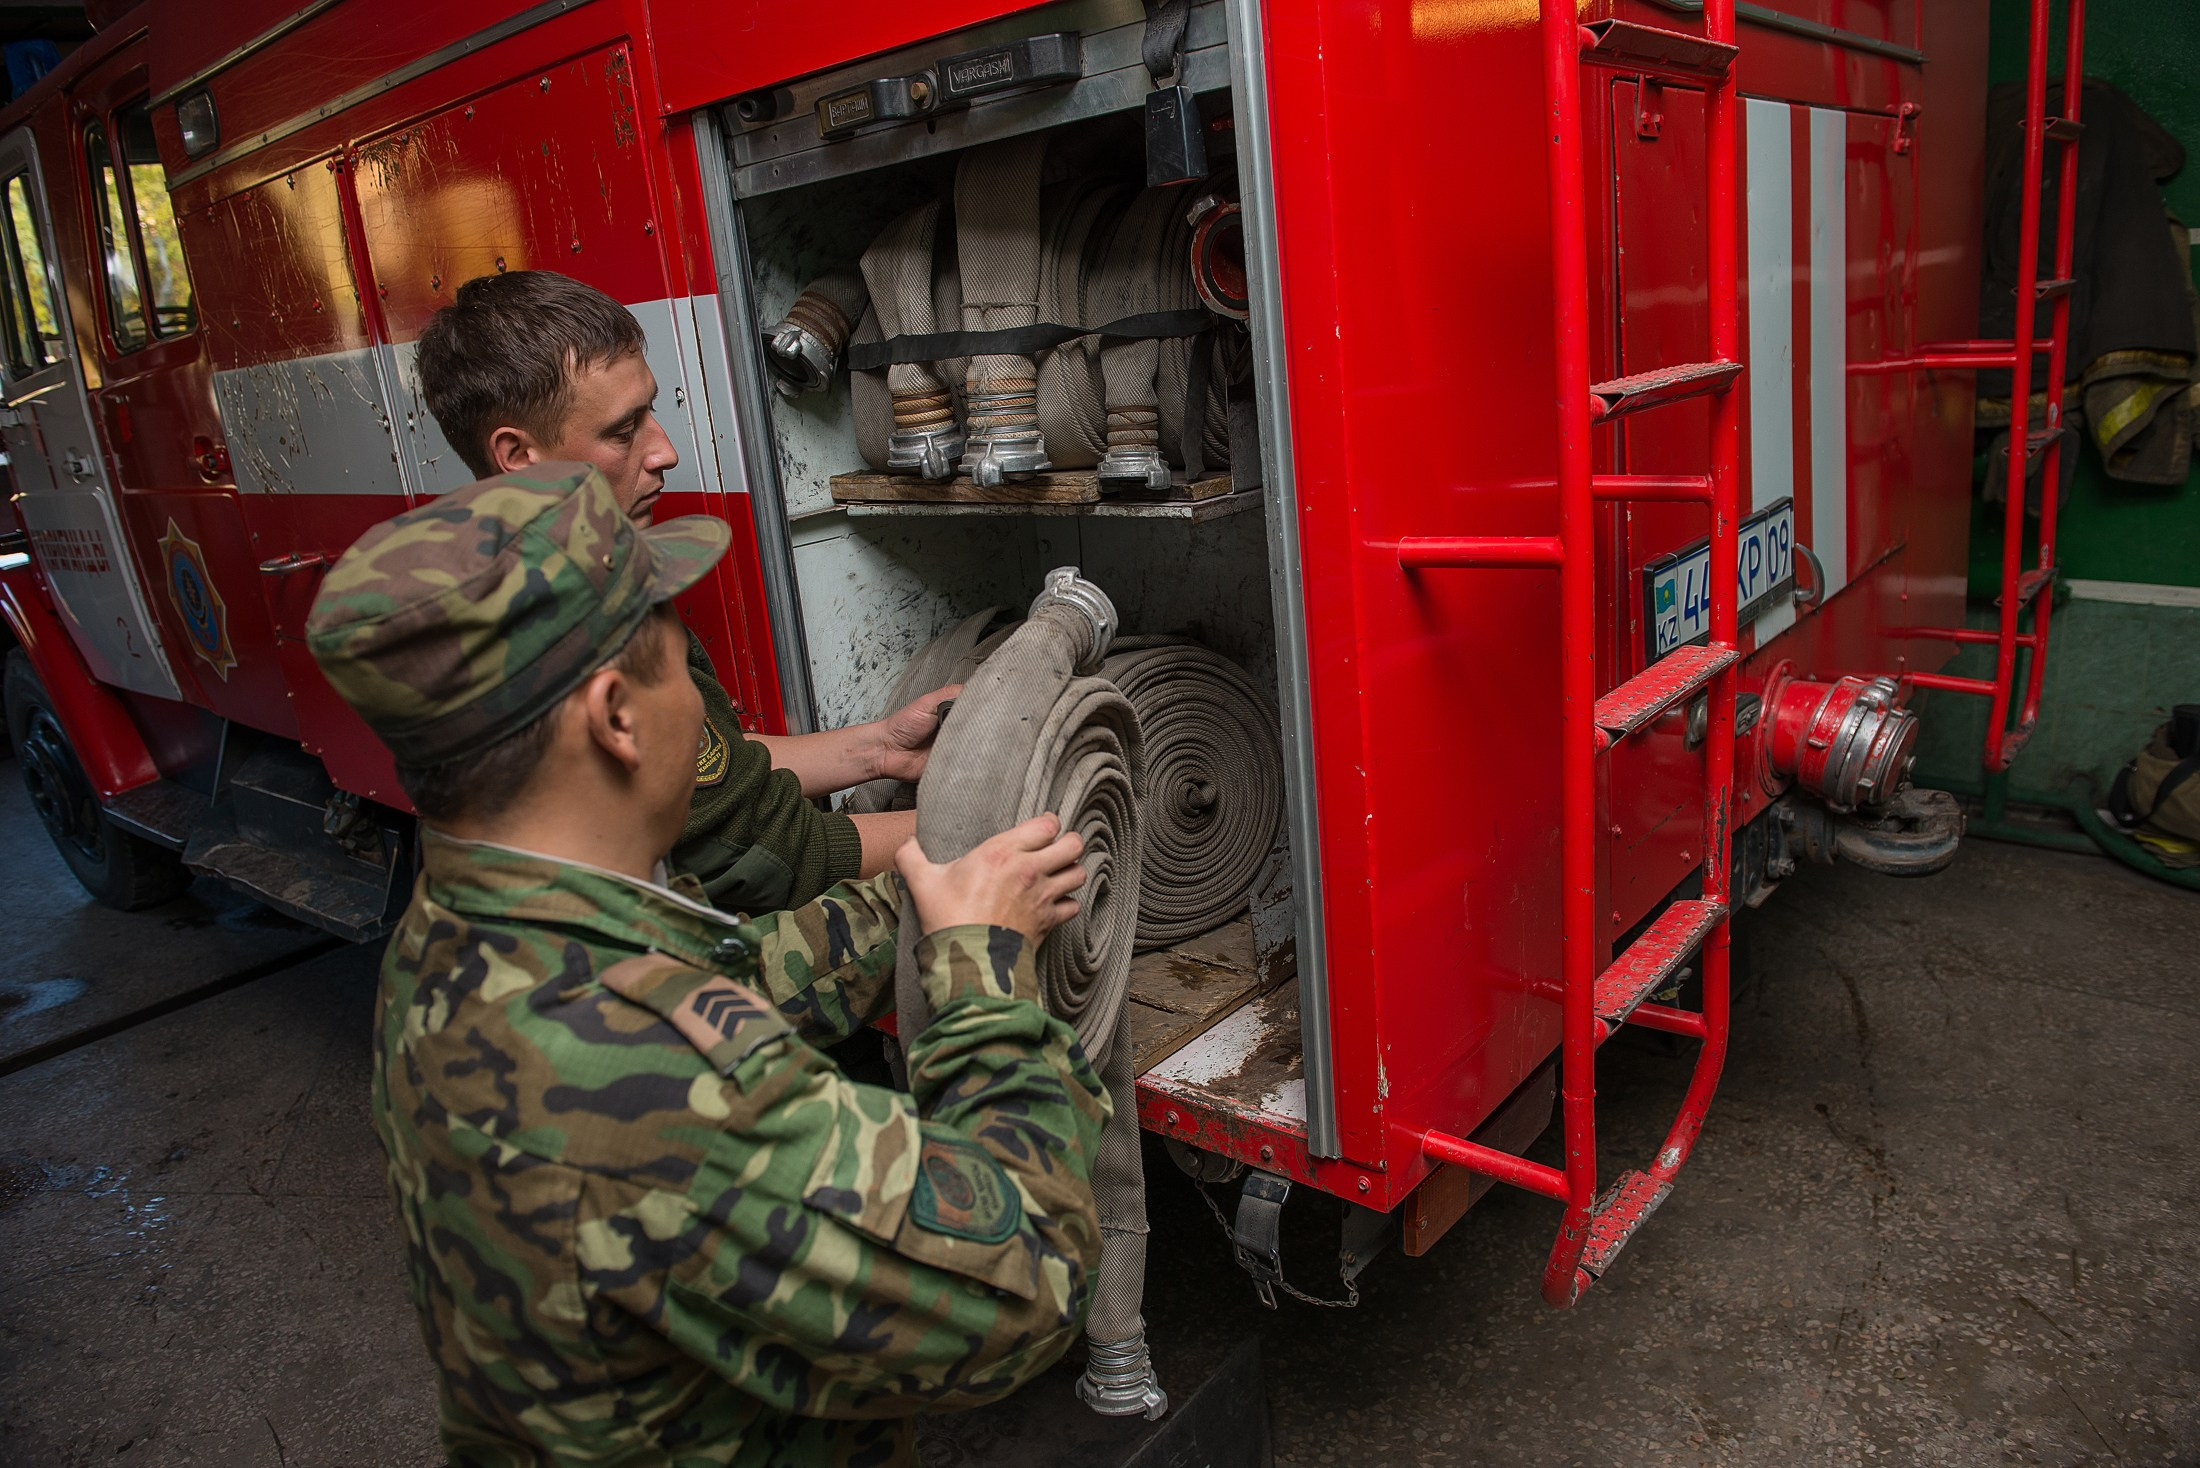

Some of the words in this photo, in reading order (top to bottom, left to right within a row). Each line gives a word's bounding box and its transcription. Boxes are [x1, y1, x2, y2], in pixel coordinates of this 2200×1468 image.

[1684, 560, 1710, 631] 44
[1768, 518, 1789, 583] 09
[117, 616, 141, 658] 2
[1658, 616, 1678, 655] KZ
